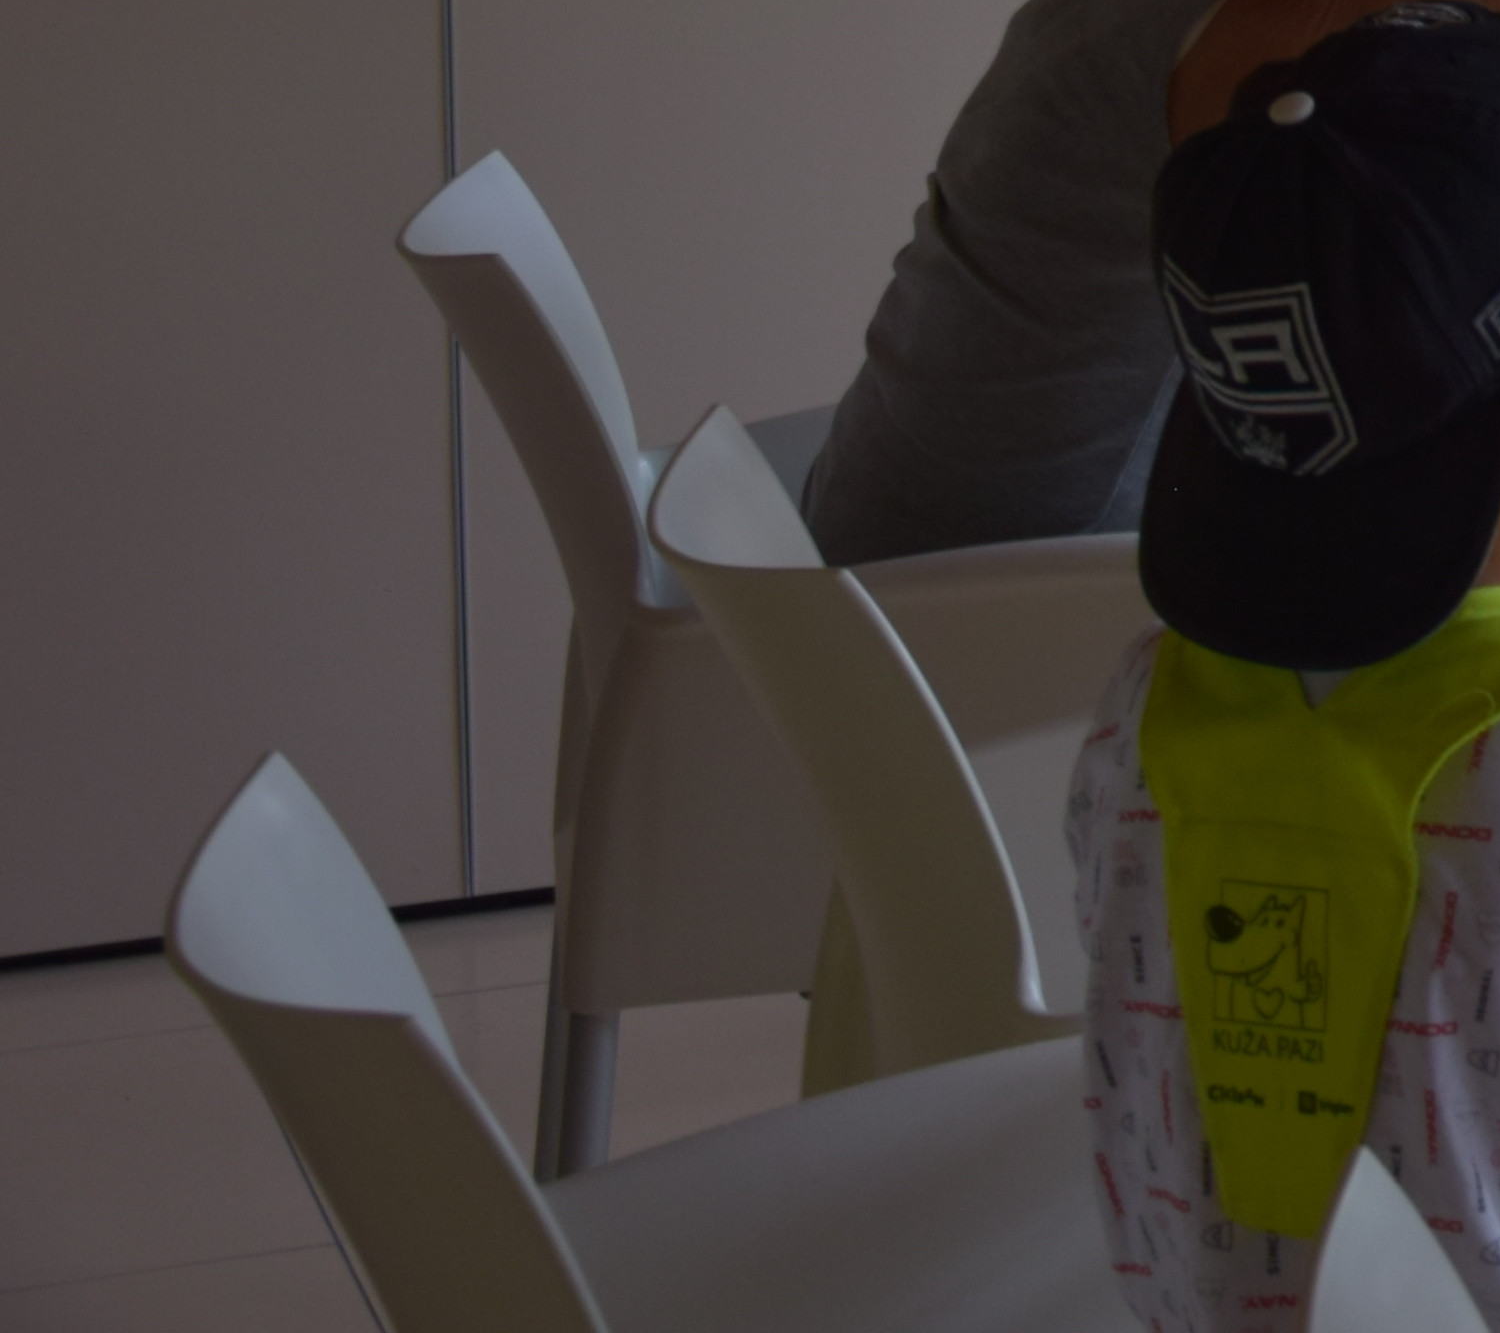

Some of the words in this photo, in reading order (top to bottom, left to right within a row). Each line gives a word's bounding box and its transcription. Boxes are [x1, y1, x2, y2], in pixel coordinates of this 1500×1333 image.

[1413, 821, 1494, 843] DONN
[1212, 1028, 1273, 1059] KUŽA
[1276, 1036, 1325, 1064] PAZI
